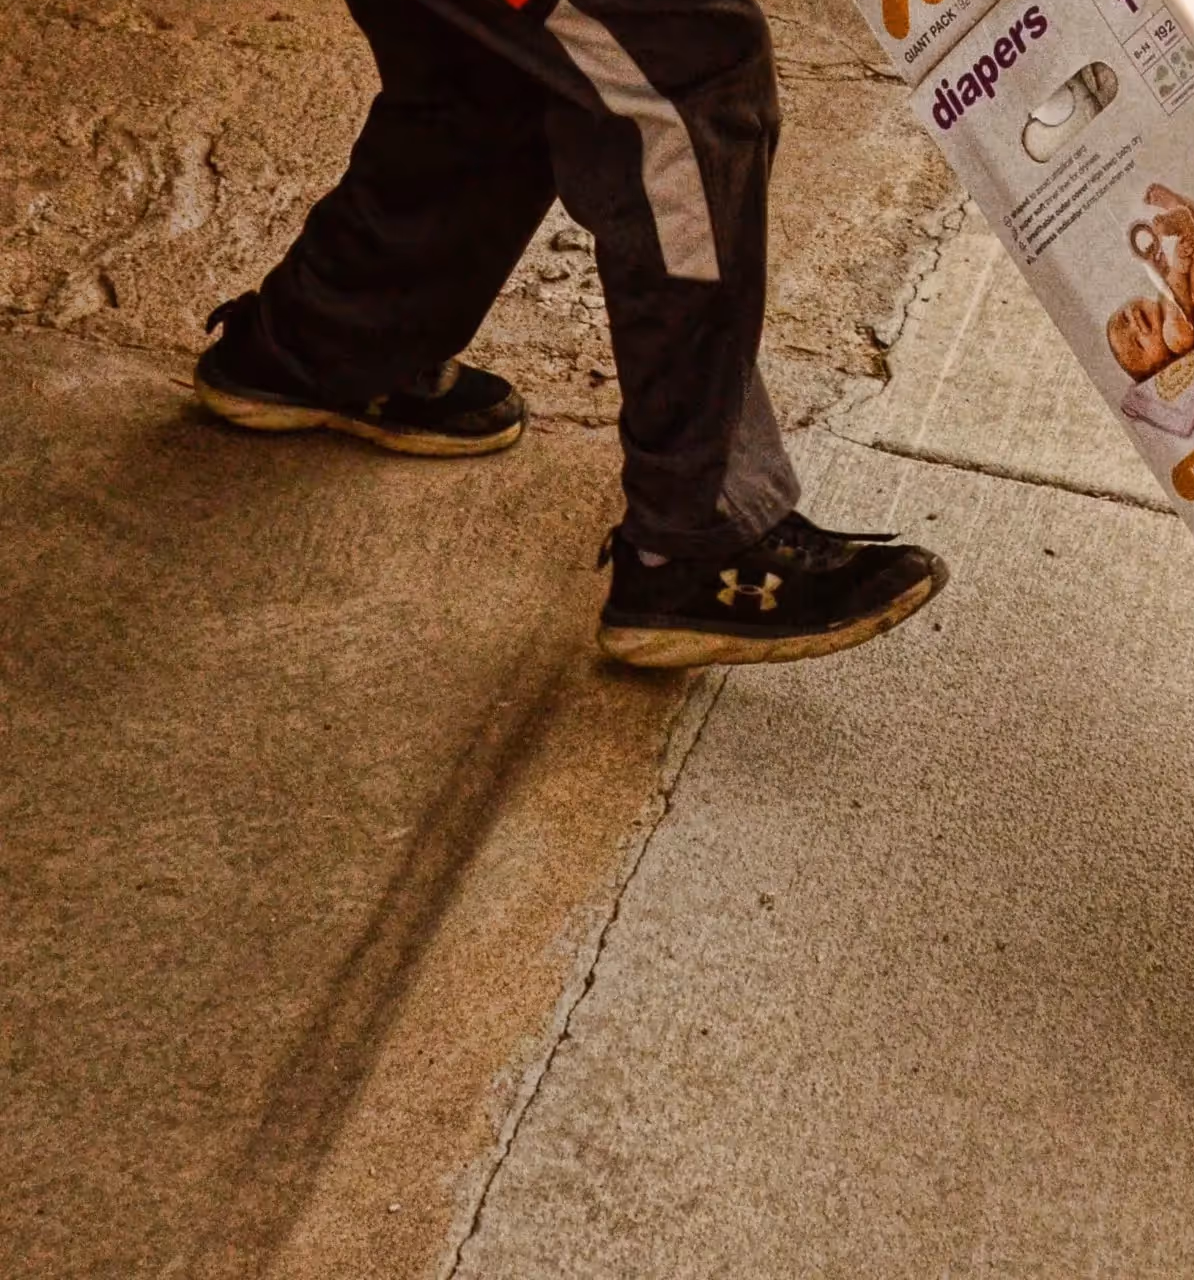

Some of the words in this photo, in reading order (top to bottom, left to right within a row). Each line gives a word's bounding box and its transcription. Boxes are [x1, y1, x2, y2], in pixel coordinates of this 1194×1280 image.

[904, 32, 931, 64] GIANT
[929, 8, 957, 37] PACK
[1153, 18, 1176, 41] 192
[932, 6, 1047, 129] diapers
